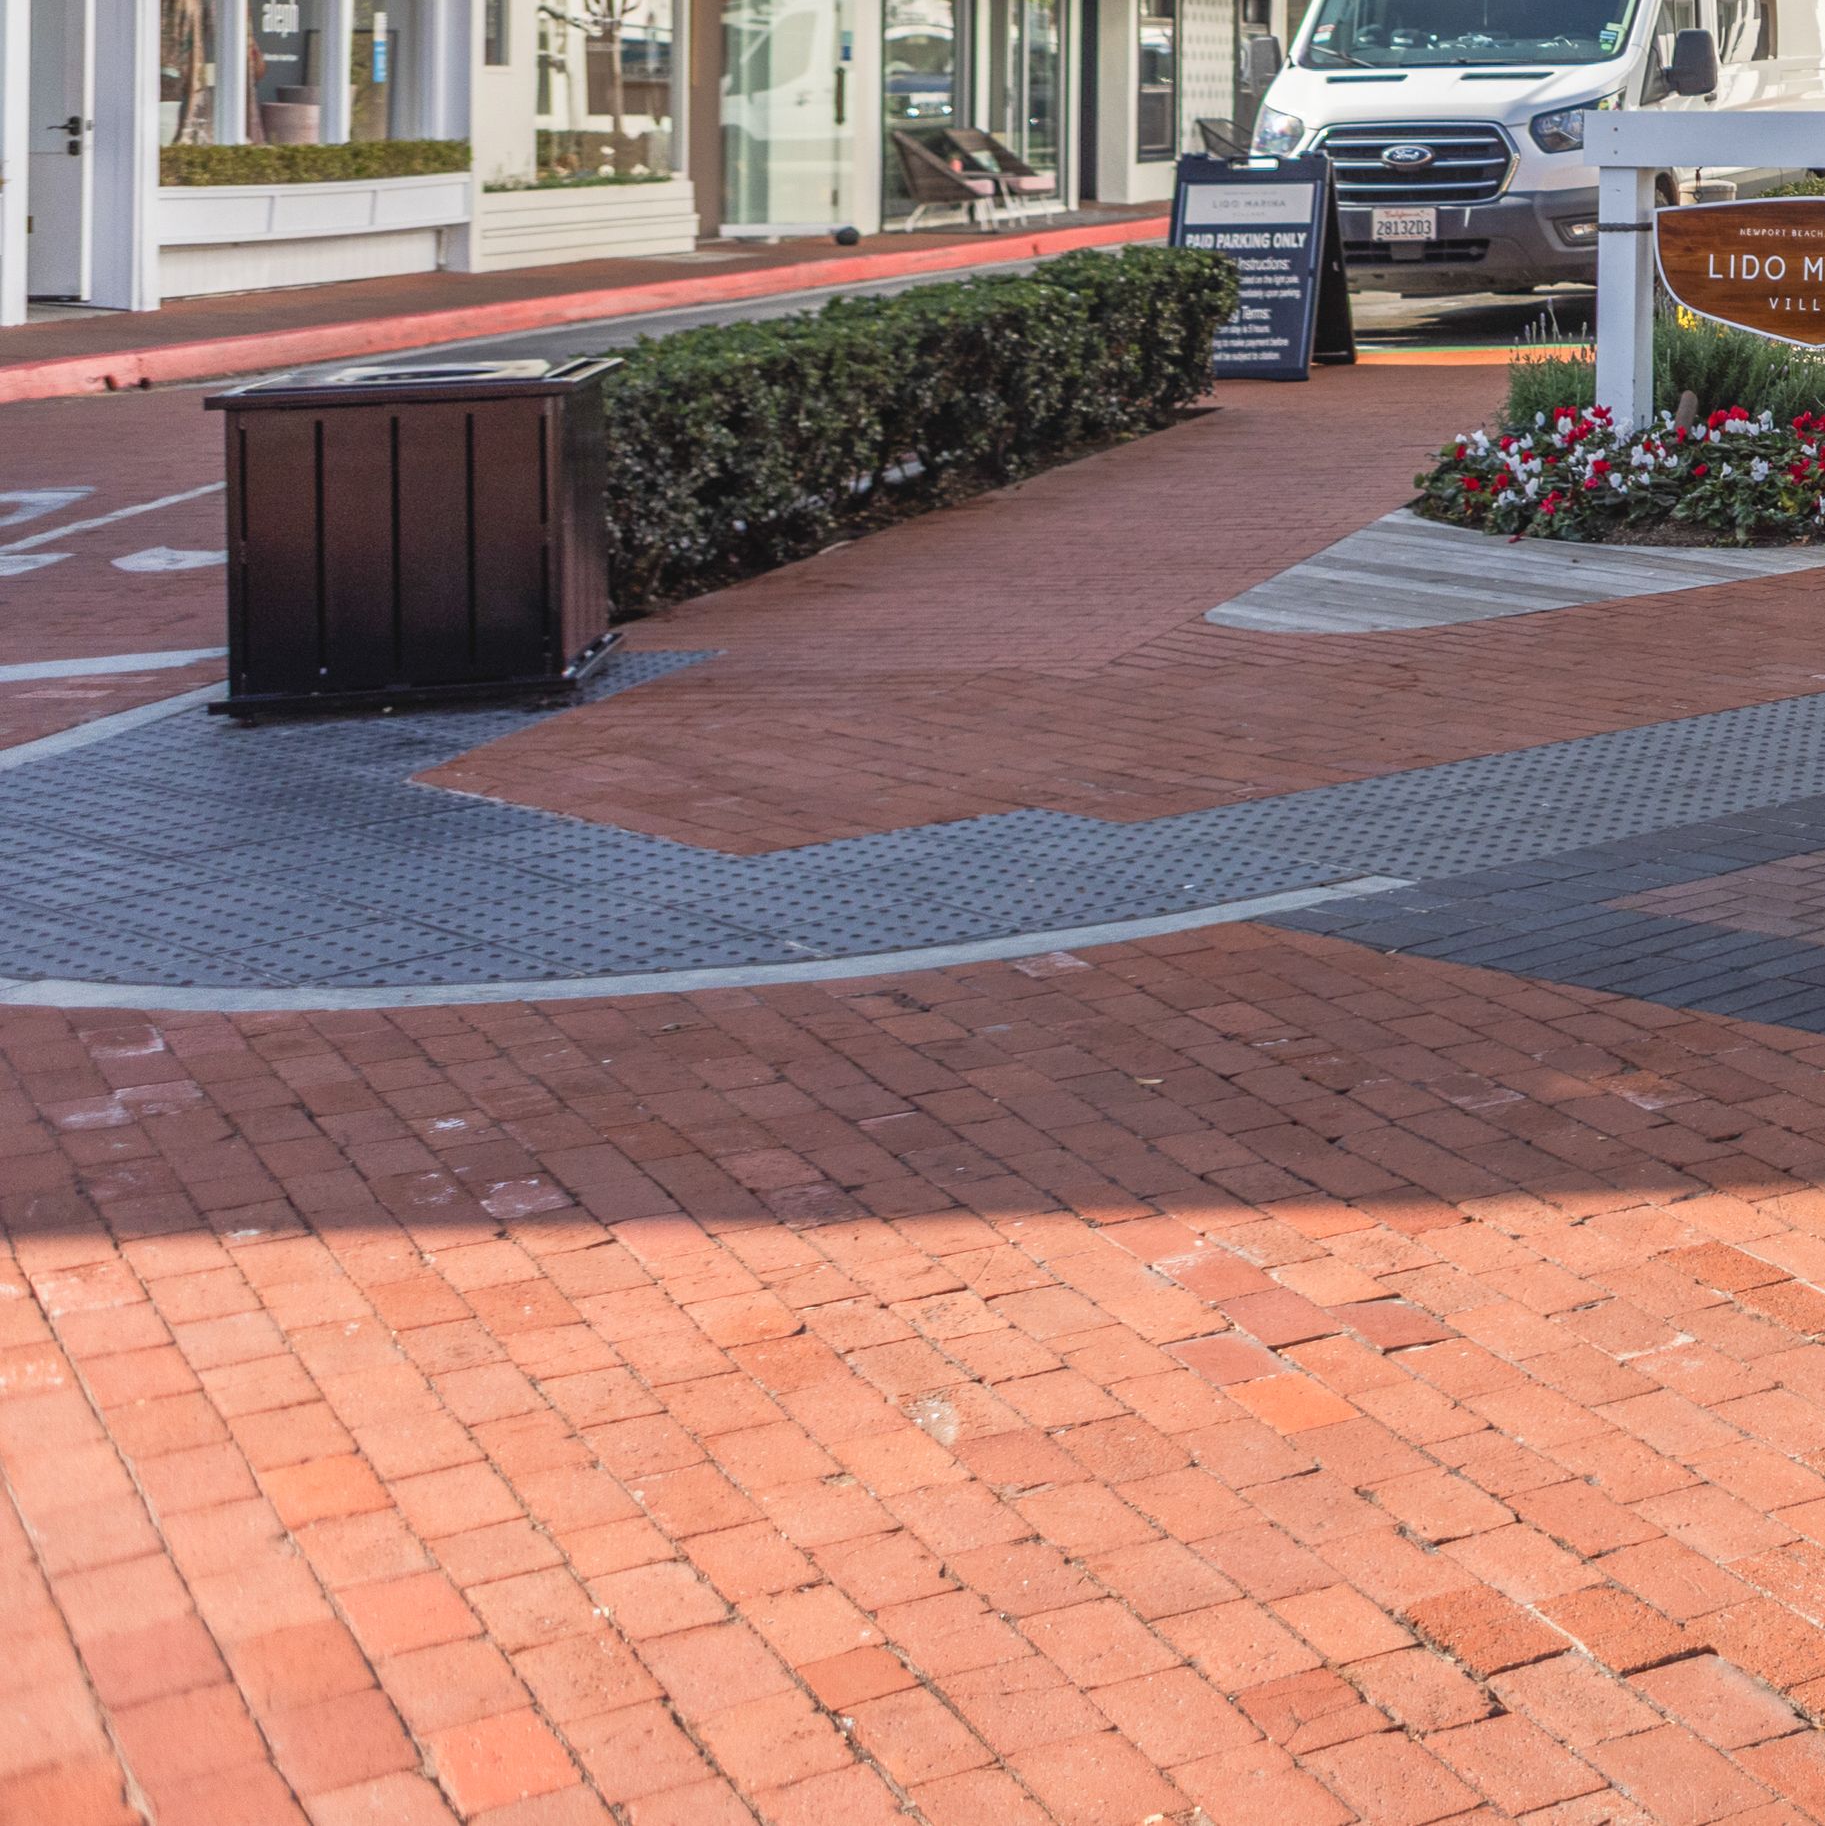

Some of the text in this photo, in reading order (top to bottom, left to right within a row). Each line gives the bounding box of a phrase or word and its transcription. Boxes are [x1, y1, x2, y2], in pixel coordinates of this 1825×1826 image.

[1185, 232, 1307, 250] PAID PARKING ONLY
[1739, 227, 1786, 237] NEWPORT
[1708, 253, 1787, 281] LIDO
